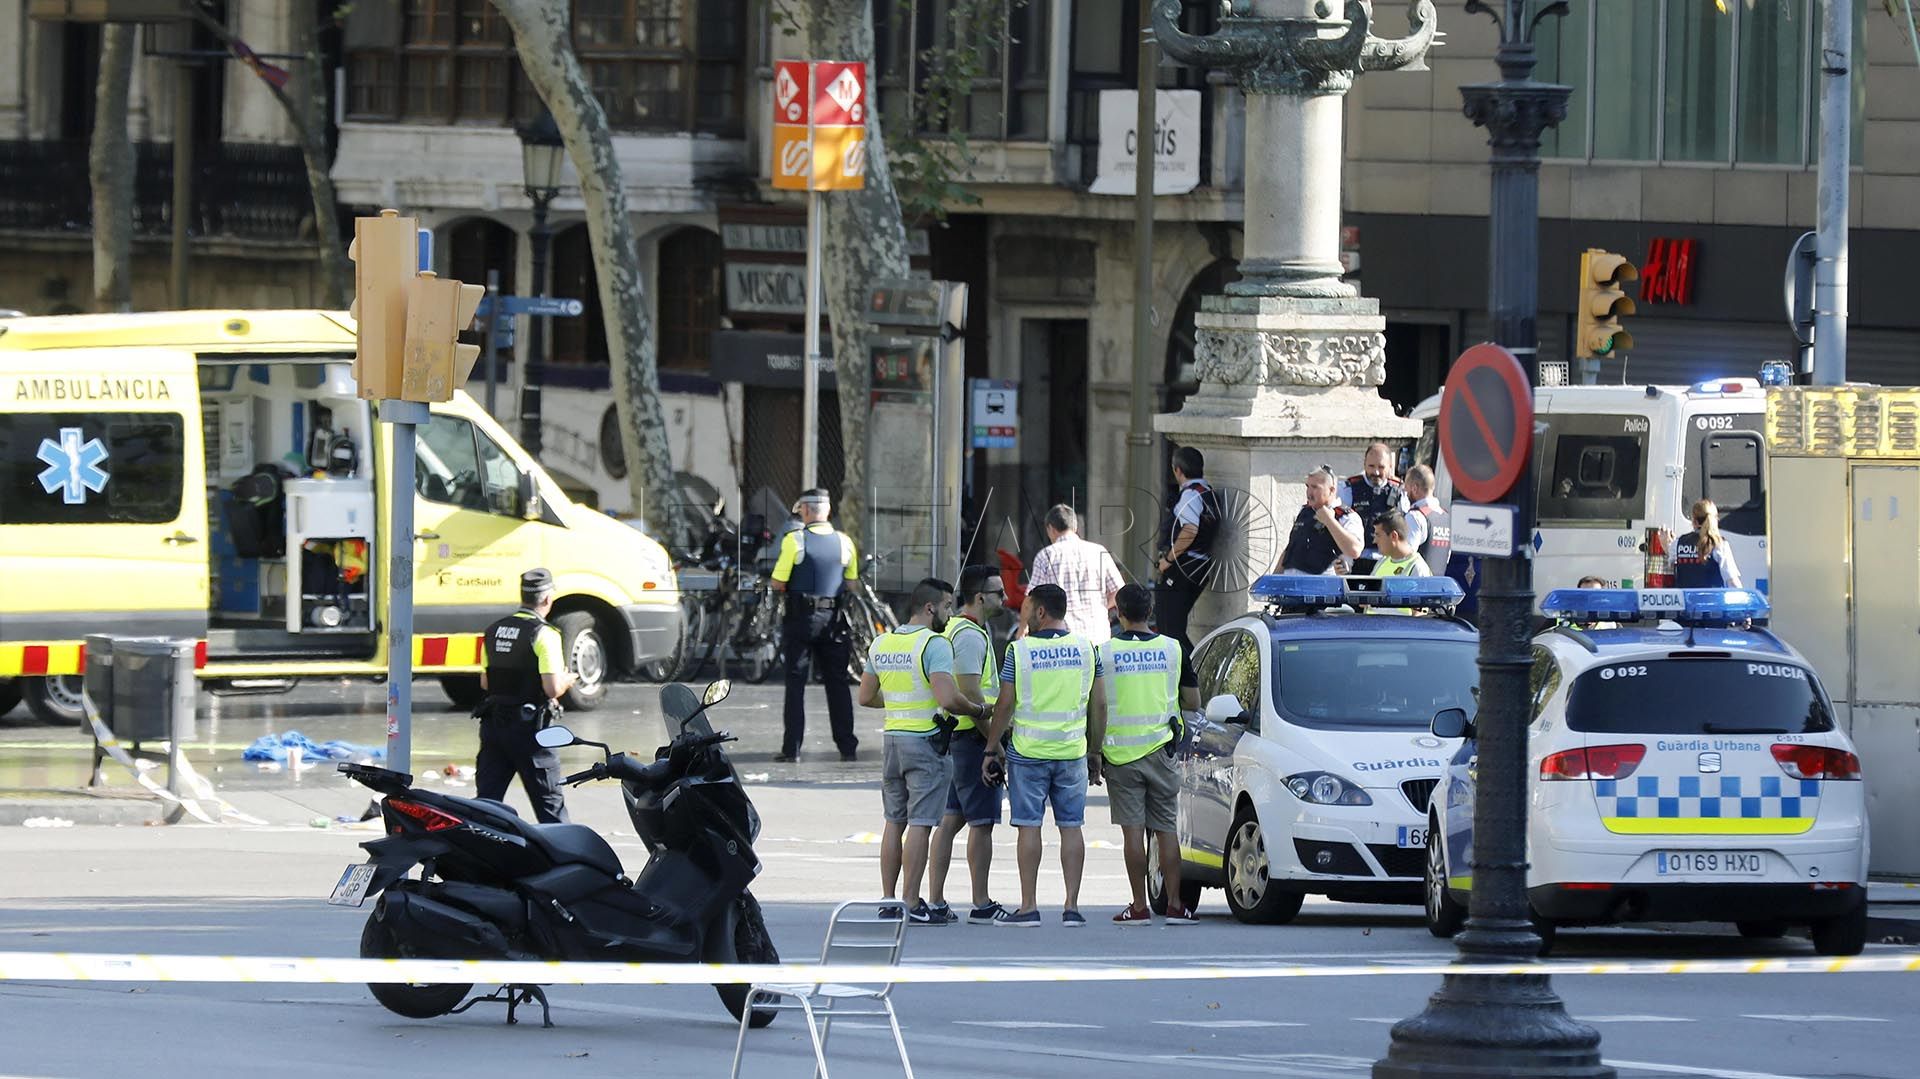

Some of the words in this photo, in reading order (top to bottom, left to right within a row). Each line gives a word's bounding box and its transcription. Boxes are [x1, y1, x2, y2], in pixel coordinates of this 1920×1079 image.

[1709, 417, 1733, 429] 092
[1641, 594, 1680, 606] POLICIA
[874, 653, 912, 665] POLICIA
[1030, 647, 1081, 661] POLICIA
[1113, 651, 1167, 665] POLICIA
[1617, 666, 1648, 678] 092
[1748, 664, 1806, 681] POLICIA
[1714, 740, 1761, 752] Urbana
[1669, 854, 1719, 872] 0169
[1724, 854, 1761, 872] HXD
